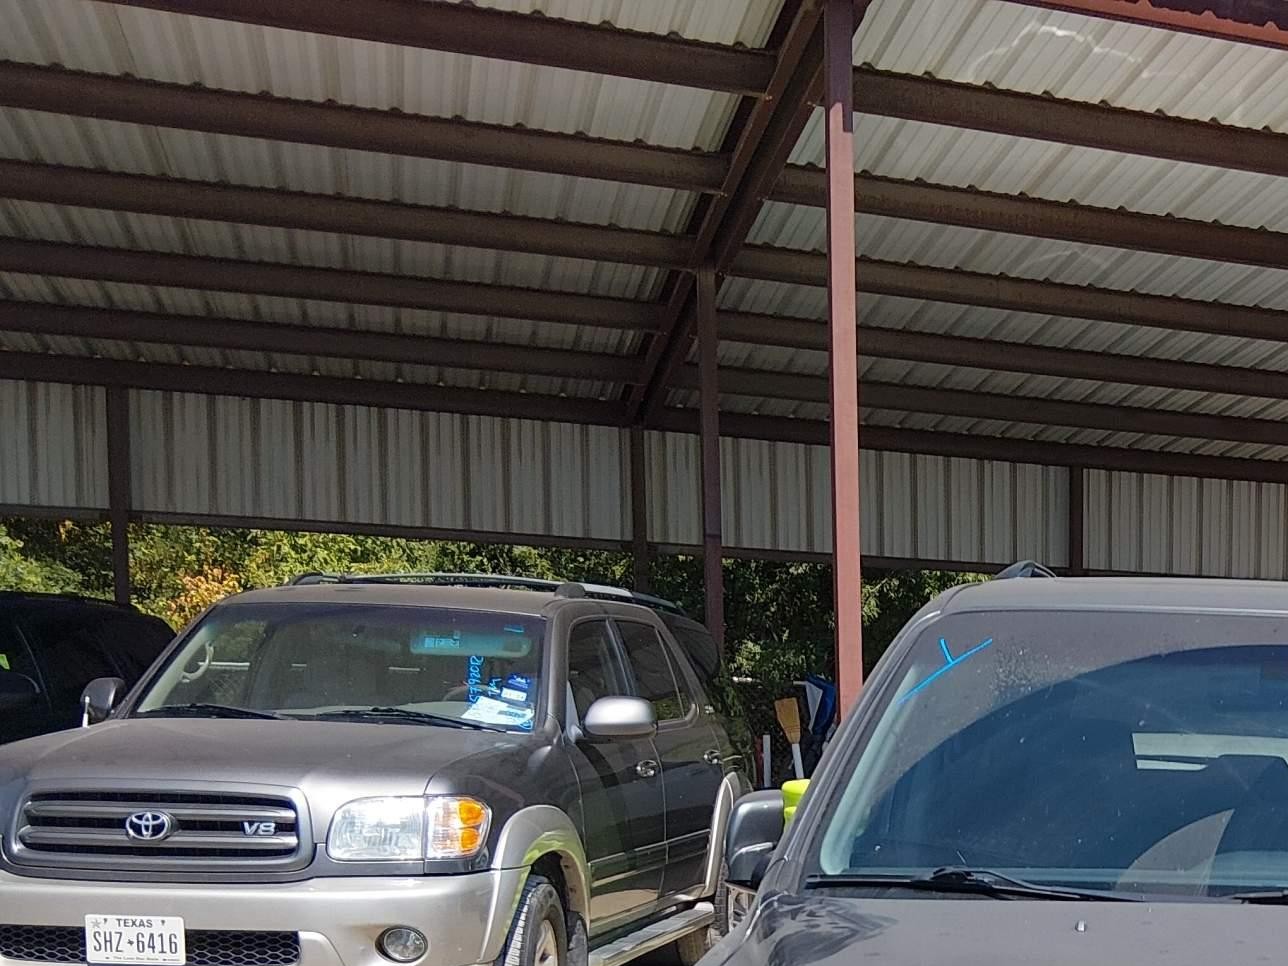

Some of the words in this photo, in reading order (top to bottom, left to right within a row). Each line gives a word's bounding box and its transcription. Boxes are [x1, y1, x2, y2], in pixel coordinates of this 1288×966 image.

[243, 821, 276, 836] V8
[116, 918, 153, 928] TEXAS
[93, 930, 123, 953] SHZ
[136, 931, 178, 954] 6416
